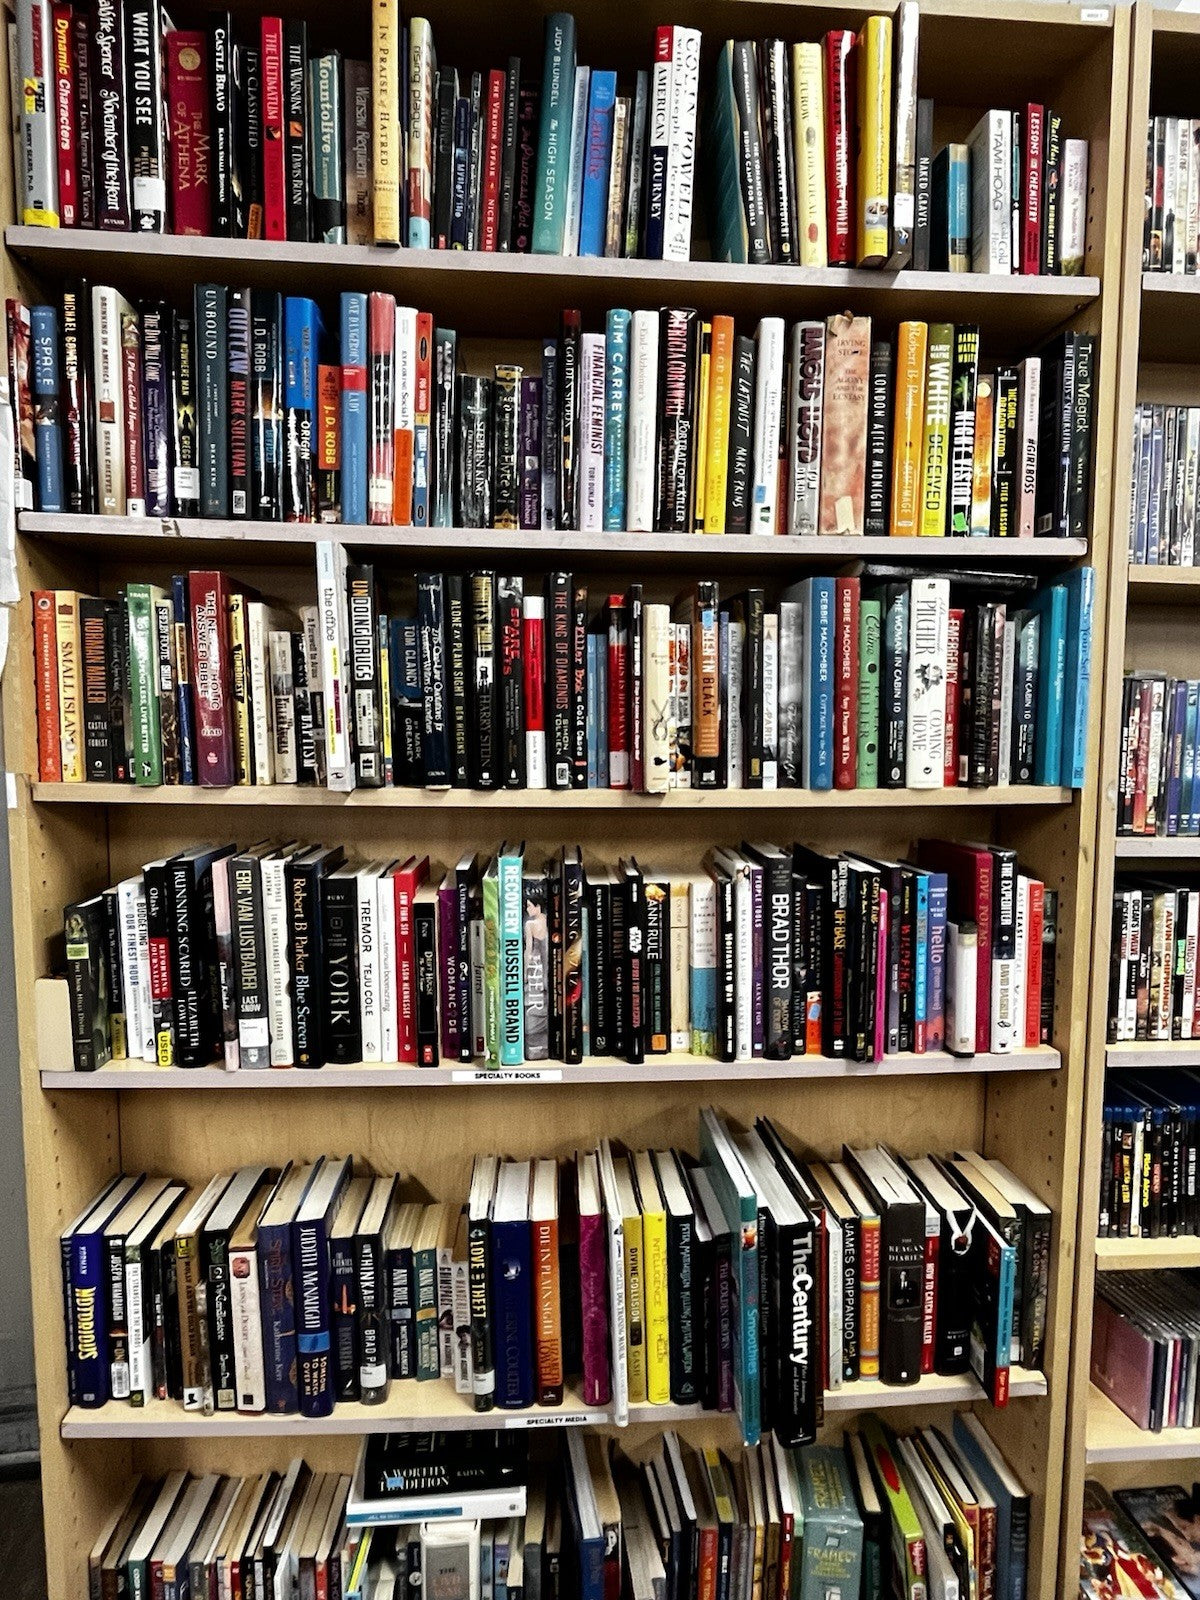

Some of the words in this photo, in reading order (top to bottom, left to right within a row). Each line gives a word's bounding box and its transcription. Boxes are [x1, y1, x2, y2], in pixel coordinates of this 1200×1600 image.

[56, 18, 70, 75] Dynamic
[132, 12, 150, 55] WHAT
[215, 28, 226, 72] CASTLE
[379, 25, 390, 40] IN
[554, 26, 563, 53] JUDY
[657, 37, 670, 57] MY
[134, 60, 151, 91] YOU
[265, 56, 279, 120] ULTIMATUM
[379, 48, 390, 96] PRAISE
[550, 56, 563, 108] BLUNDELL
[216, 73, 227, 112] BRAVO
[355, 87, 370, 126] Warsaw
[655, 66, 668, 141] AMERICAN
[59, 79, 72, 150] Characters
[135, 97, 152, 126] SEE
[379, 112, 391, 167] HATRED
[548, 135, 557, 166] HIGH
[992, 130, 1004, 163] TAMI
[1029, 112, 1041, 156] LESSONS
[353, 130, 369, 178] Requiem
[650, 153, 664, 221] JOURNEY
[677, 130, 694, 225] POWELL
[918, 156, 930, 192] NAKED
[991, 165, 1004, 211] HOAG
[544, 169, 557, 220] SEASON
[917, 193, 929, 228] GRAVES
[1028, 170, 1041, 223] CHEMISTRY
[205, 290, 218, 360] UNBOUND
[228, 307, 249, 376] OUTLAW
[612, 314, 625, 345] JIM
[253, 343, 267, 373] ROBB
[592, 343, 605, 401] FINANCIAL
[739, 351, 752, 374] THE
[1078, 343, 1092, 379] True
[181, 379, 190, 396] MAN
[231, 379, 246, 416] MARK
[610, 352, 624, 425] CARREY
[873, 373, 887, 418] LONDON
[926, 361, 950, 427] WHITE
[737, 376, 752, 437] LATINIST
[1074, 382, 1091, 433] Magick
[231, 419, 247, 477] SULLIVAN
[300, 420, 311, 460] ORIGIN
[590, 404, 604, 456] FEMINIST
[325, 432, 336, 465] ROBB
[734, 445, 748, 476] MARK
[1023, 438, 1036, 495] #GIRLBOSS
[869, 456, 884, 513] MIDNIGHT
[926, 433, 943, 511] DECEIVED
[732, 478, 746, 508] PRINS
[206, 591, 216, 615] THE
[324, 588, 335, 606] the
[554, 590, 567, 609] THE
[820, 591, 829, 627] DEBBIE
[843, 588, 852, 625] DEBBIE
[894, 594, 903, 612] THE
[84, 617, 105, 663] NORMAN
[196, 605, 208, 659] ANSWER
[325, 609, 336, 642] office
[404, 625, 415, 646] TOM
[554, 614, 568, 637] KING
[893, 614, 903, 655] WOMAN
[914, 598, 937, 656] PILCHER
[1028, 619, 1036, 636] THE
[353, 636, 374, 681] DRUGS
[554, 639, 568, 655] OF
[819, 628, 829, 682] MACOMBER
[842, 626, 852, 680] MACOMBER
[893, 657, 902, 667] IN
[1026, 637, 1035, 670] WOMAN
[61, 641, 75, 692] SMALL
[87, 665, 107, 704] MAILER
[199, 662, 210, 698] BIBLE
[405, 649, 417, 688] CLANCY
[893, 669, 902, 699] CABIN
[1025, 671, 1034, 681] IN
[702, 676, 715, 717] BLACK
[893, 702, 902, 713] 10
[1024, 682, 1033, 707] CABIN
[576, 704, 585, 727] Cold
[1023, 709, 1032, 720] 10
[236, 869, 252, 895] ERIC
[978, 867, 990, 899] LOVE
[1001, 862, 1014, 879] THE
[174, 870, 188, 932] RUNNING
[238, 897, 254, 926] VAN
[293, 877, 307, 917] Robert
[504, 865, 520, 935] RECOVERY
[568, 879, 580, 941] SAVING
[647, 900, 659, 927] ANN
[1131, 899, 1140, 928] OCEAN'S
[126, 913, 135, 930] OUR
[360, 899, 373, 954] TREMOR
[771, 893, 790, 942] BRAD
[834, 909, 847, 926] OFF
[978, 904, 989, 948] POEMS
[1016, 911, 1024, 939] FEAST
[1164, 910, 1173, 941] ALVIN
[127, 933, 138, 961] FINEST
[295, 933, 309, 973] Parker
[646, 929, 659, 960] RULE
[833, 926, 846, 951] BASE
[930, 925, 945, 964] hello
[1186, 935, 1196, 963] HANDS
[129, 964, 139, 986] HOUR
[159, 943, 169, 993] REFORMING
[178, 936, 191, 987] SCARED
[239, 928, 258, 990] LUSTBADER
[362, 963, 373, 986] TEJU
[505, 939, 519, 995] RUSSELL
[724, 971, 734, 981] TO
[772, 943, 790, 989] THOR
[242, 996, 259, 1005] LAST
[295, 975, 310, 1002] Blue
[329, 955, 351, 1026] YORK
[724, 983, 734, 1003] WAR
[1161, 953, 1172, 1013] CHIPMUNKS
[1184, 969, 1194, 996] STONE
[187, 990, 200, 1047] ELIZABETH
[241, 1004, 261, 1013] SNOW
[364, 989, 374, 1017] COLE
[506, 998, 520, 1044] BRAND
[296, 1005, 311, 1050] Screen
[159, 1035, 169, 1063] USED
[474, 1072, 513, 1080] SPECIALTY
[300, 1228, 318, 1268] JUDITH
[470, 1240, 486, 1270] LOVE
[844, 1222, 856, 1265] JAMES
[888, 1254, 925, 1262] DIARIES
[111, 1254, 123, 1282] JOSEPH
[925, 1262, 935, 1279] HOW
[925, 1280, 934, 1290] TO
[111, 1282, 124, 1321] WAMBAUGH
[393, 1286, 409, 1307] RULE
[419, 1286, 434, 1307] RULE
[471, 1282, 488, 1319] THEFT
[843, 1268, 856, 1340] GRIPPANDO
[924, 1290, 934, 1314] CATCH
[75, 1286, 99, 1361] NOTORIOUS
[364, 1329, 377, 1354] BRAD
[922, 1321, 933, 1345] KILLER
[311, 1358, 319, 1369] TO
[526, 1417, 563, 1425] SPECIALTY
[564, 1415, 588, 1423] MEDIA
[392, 1465, 449, 1478] WORTHY
